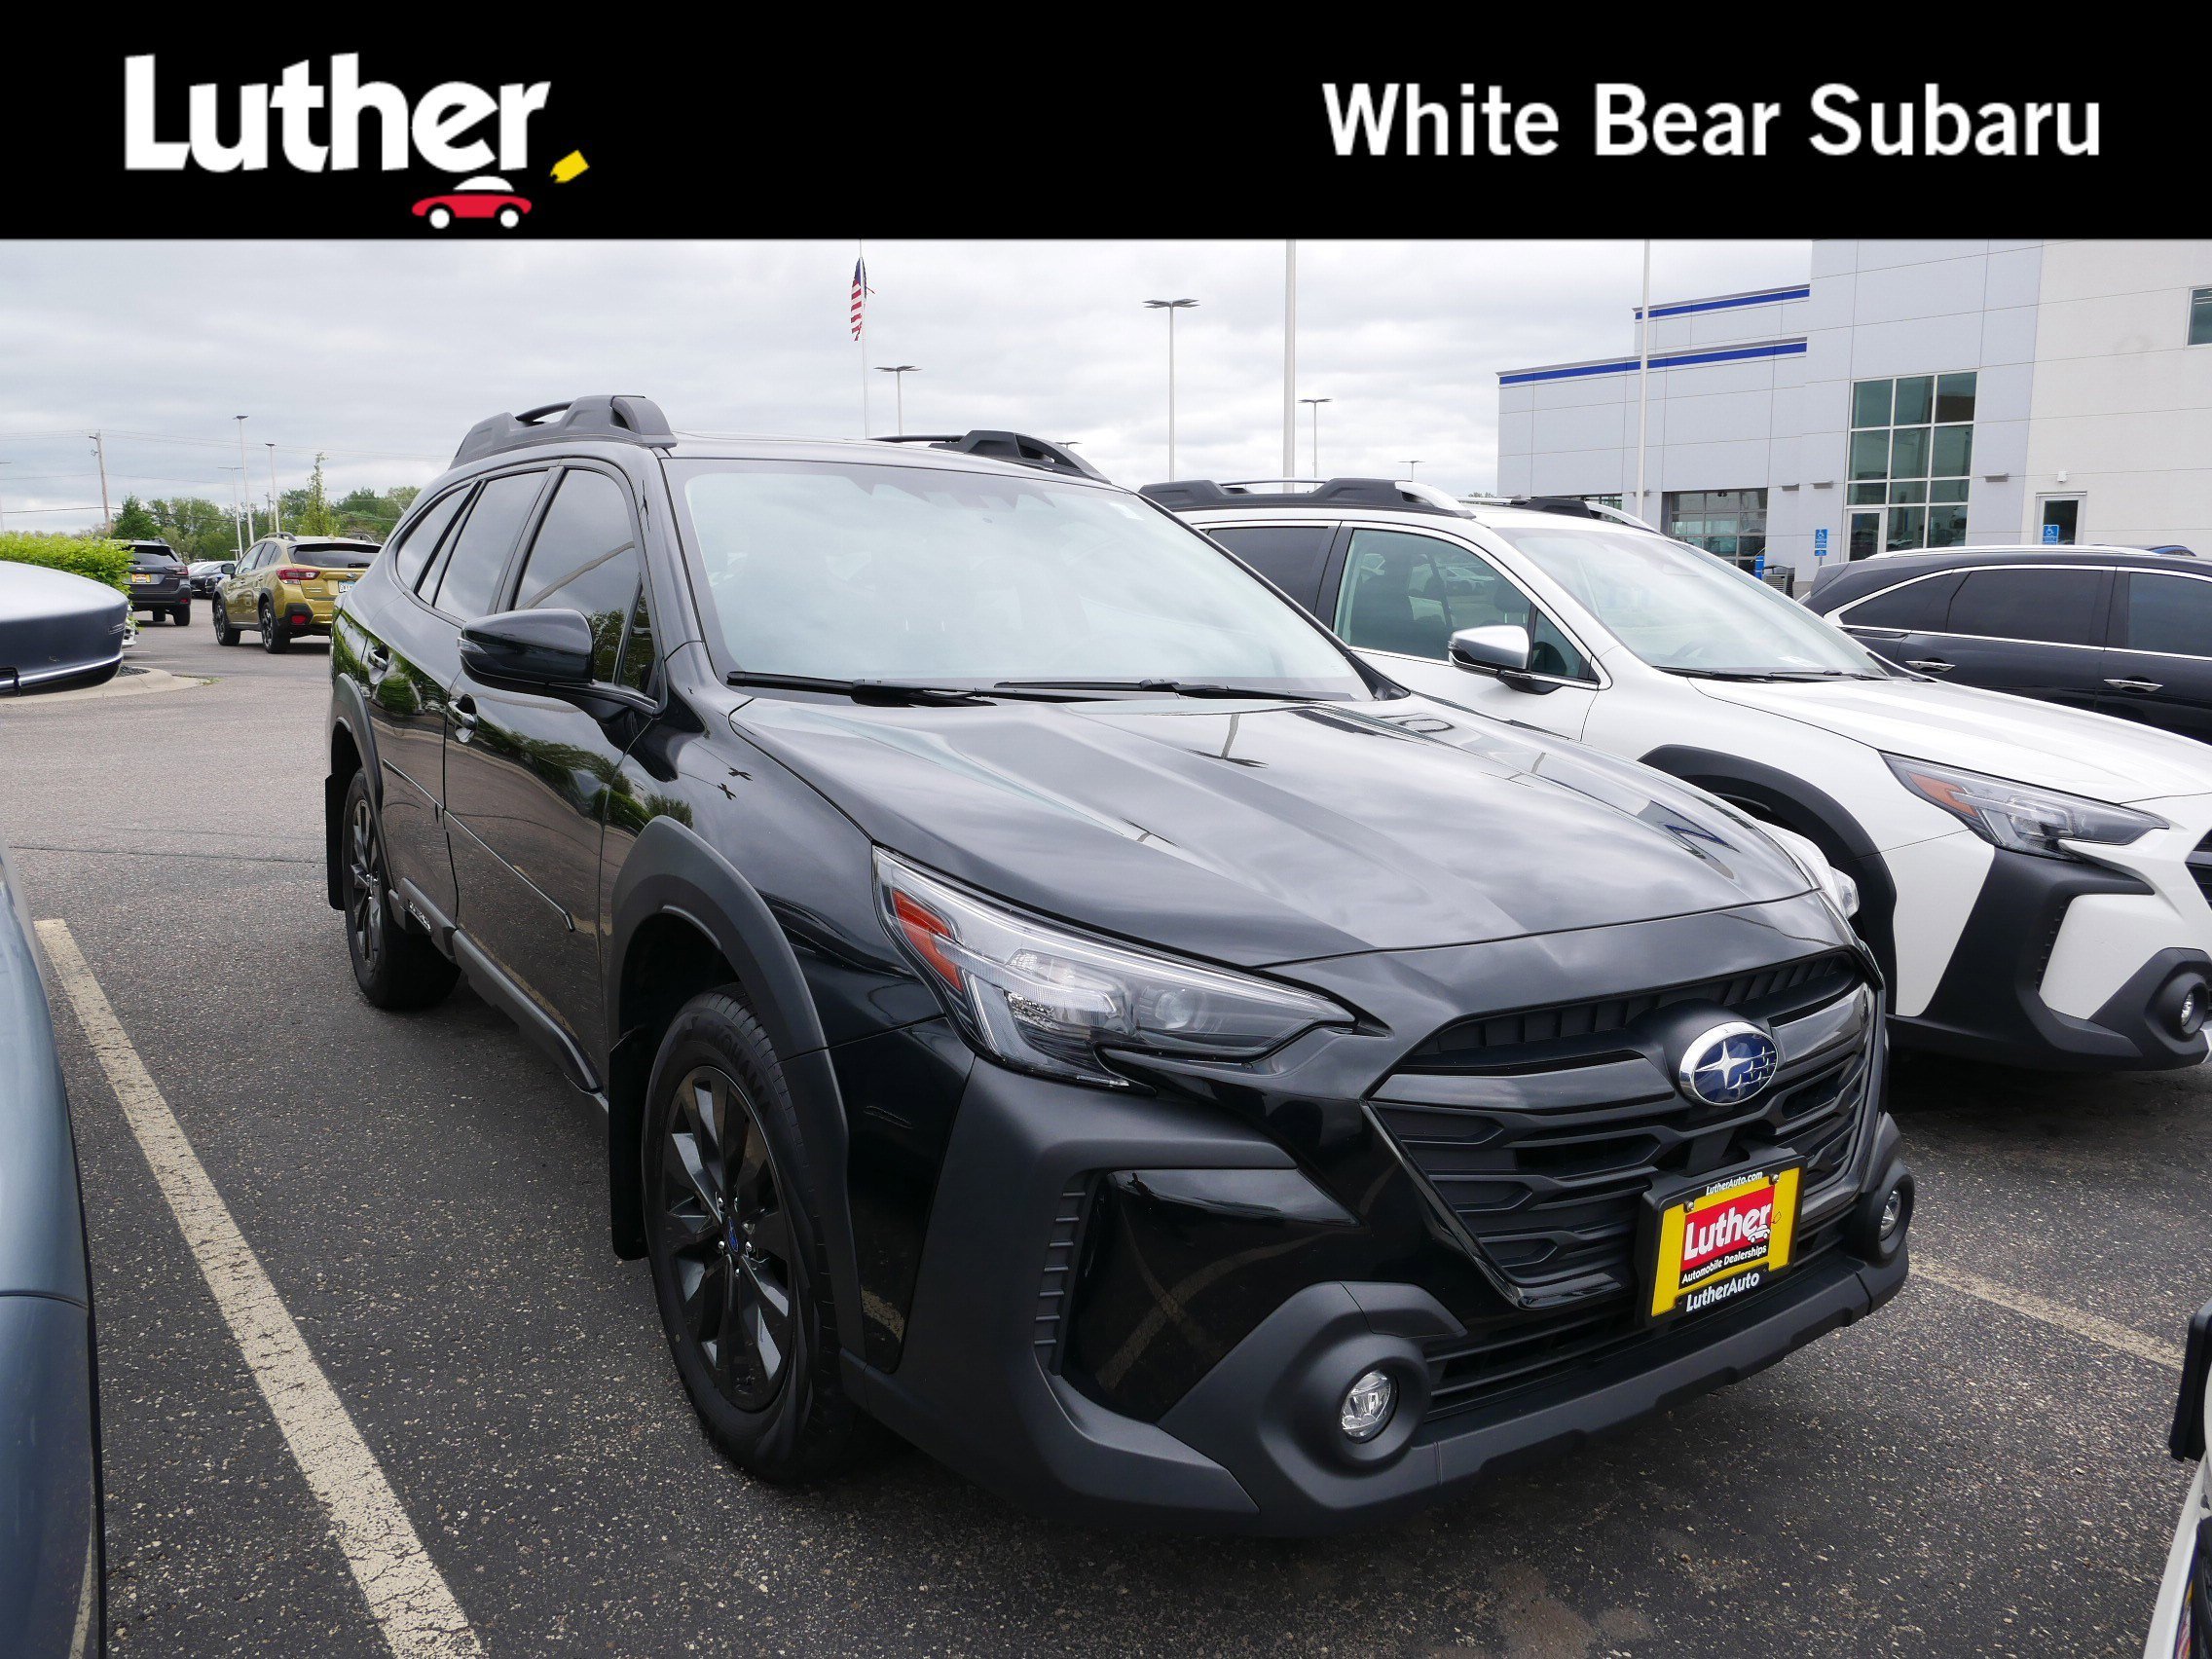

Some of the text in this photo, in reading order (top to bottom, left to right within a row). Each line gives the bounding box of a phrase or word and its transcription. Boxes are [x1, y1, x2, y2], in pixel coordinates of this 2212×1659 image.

[1705, 1171, 1763, 1197] LutherAuto.com
[1683, 1202, 1773, 1261] Luther
[1681, 1244, 1767, 1284] Automobile Dealerships
[1685, 1272, 1760, 1312] LutherAuto
